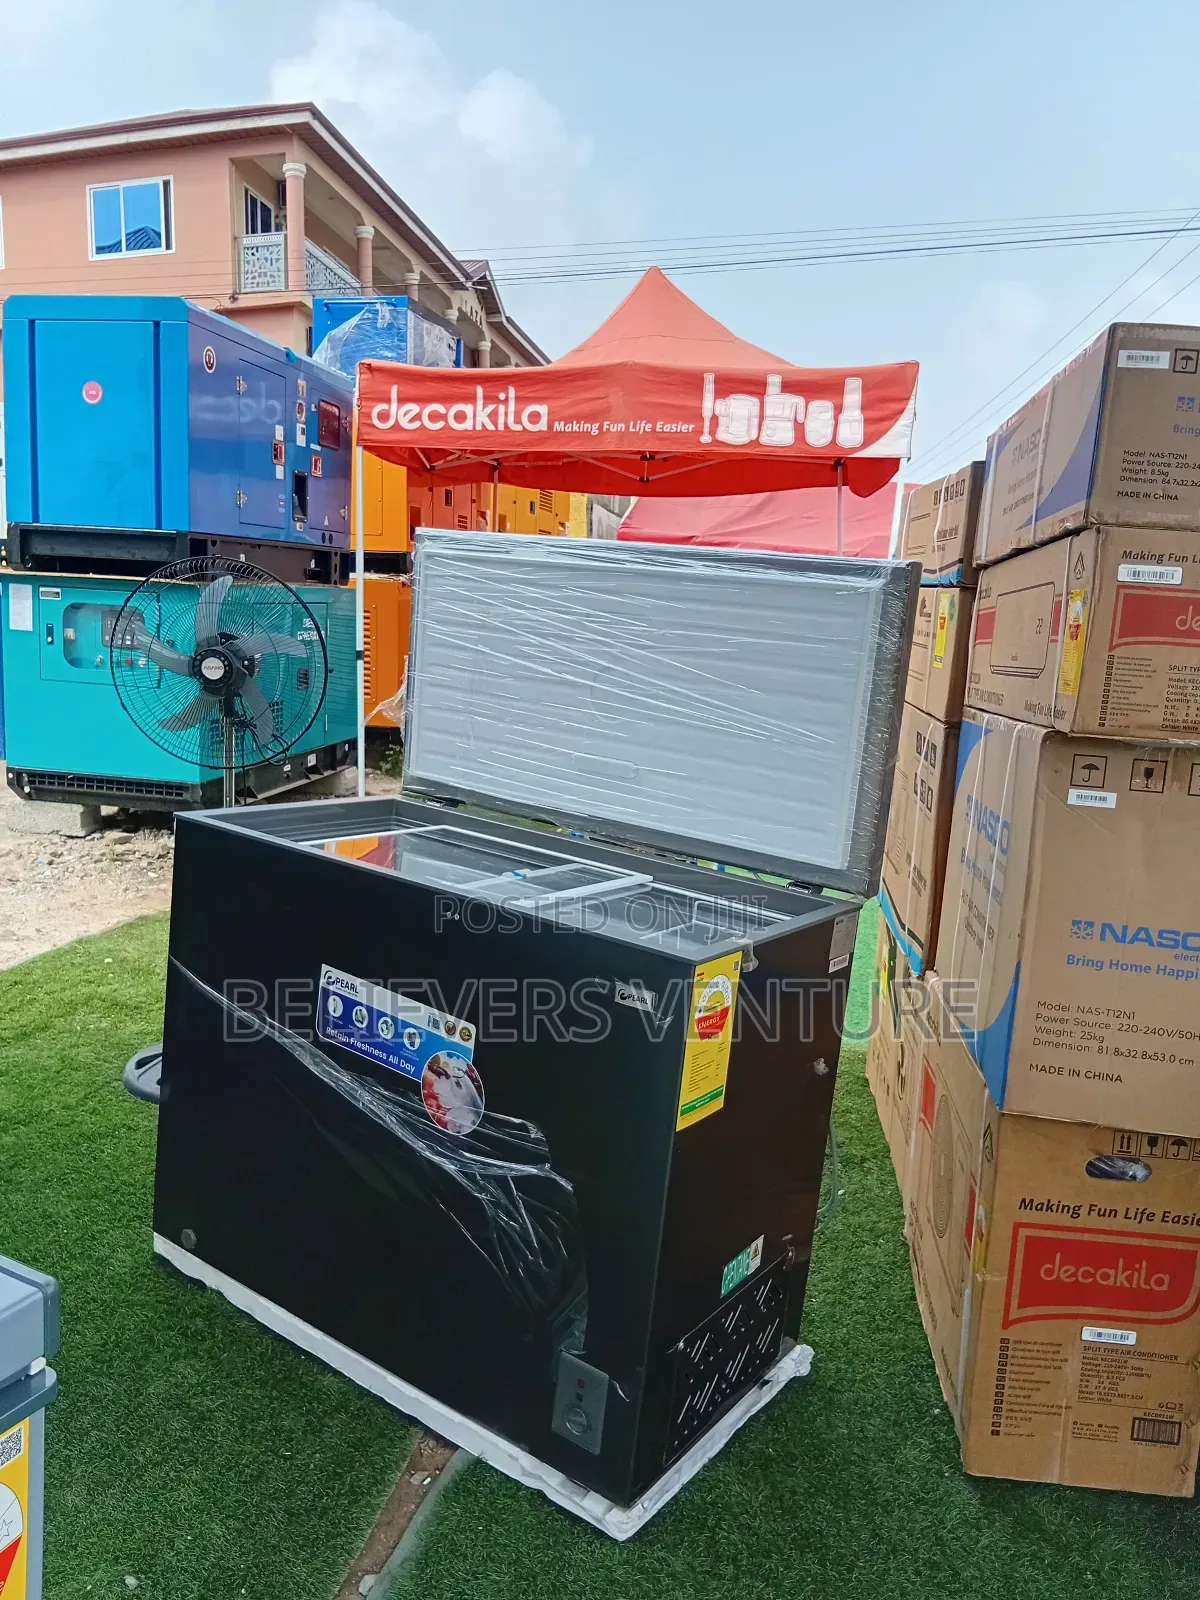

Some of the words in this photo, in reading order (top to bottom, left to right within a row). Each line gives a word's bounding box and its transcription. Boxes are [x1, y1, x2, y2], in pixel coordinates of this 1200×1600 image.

[371, 385, 548, 432] decakila
[553, 421, 599, 435] Making
[603, 421, 625, 433] Fun
[629, 421, 652, 435] Life
[656, 421, 695, 434] Easier
[1147, 460, 1173, 468] Source:
[1149, 452, 1187, 460] NAS-T12N1
[1120, 476, 1159, 485] Dimension:
[1121, 467, 1148, 476] Weight:
[1151, 469, 1169, 477] 8.5kg
[1117, 491, 1140, 499] MADE
[1154, 493, 1179, 501] CHINA
[1121, 550, 1165, 564] Making
[1168, 553, 1188, 563] Fun
[1066, 954, 1105, 971] Bring
[1108, 959, 1152, 974] Home
[335, 977, 359, 994] PEARL
[628, 993, 649, 1006] PEARL
[1037, 1000, 1073, 1013] Model:
[1076, 1005, 1136, 1020] NAS-T12N1
[698, 1015, 720, 1030] ENERGY
[1035, 1013, 1070, 1026] Power
[1073, 1017, 1114, 1031] Source:
[1034, 1025, 1076, 1040] Weight:
[1079, 1030, 1105, 1044] 25kg
[326, 1026, 349, 1043] Retain
[350, 1037, 387, 1061] Freshness
[388, 1053, 399, 1065] All
[400, 1058, 416, 1075] Day
[1032, 1037, 1093, 1053] Dimension:
[1097, 1045, 1176, 1064] 81.8x32.8x53.0
[1179, 1057, 1194, 1066] cm
[1029, 1063, 1064, 1076] MADE
[1068, 1068, 1081, 1078] IN
[1084, 1070, 1123, 1084] CHINA
[1018, 1197, 1083, 1219] Making
[1087, 1203, 1118, 1219] Fun
[1123, 1207, 1156, 1225] Life
[1039, 1252, 1170, 1291] decakila
[1083, 1345, 1101, 1353] SPLIT
[1103, 1347, 1120, 1355] TYPE
[1132, 1350, 1179, 1361] CONDITIONER
